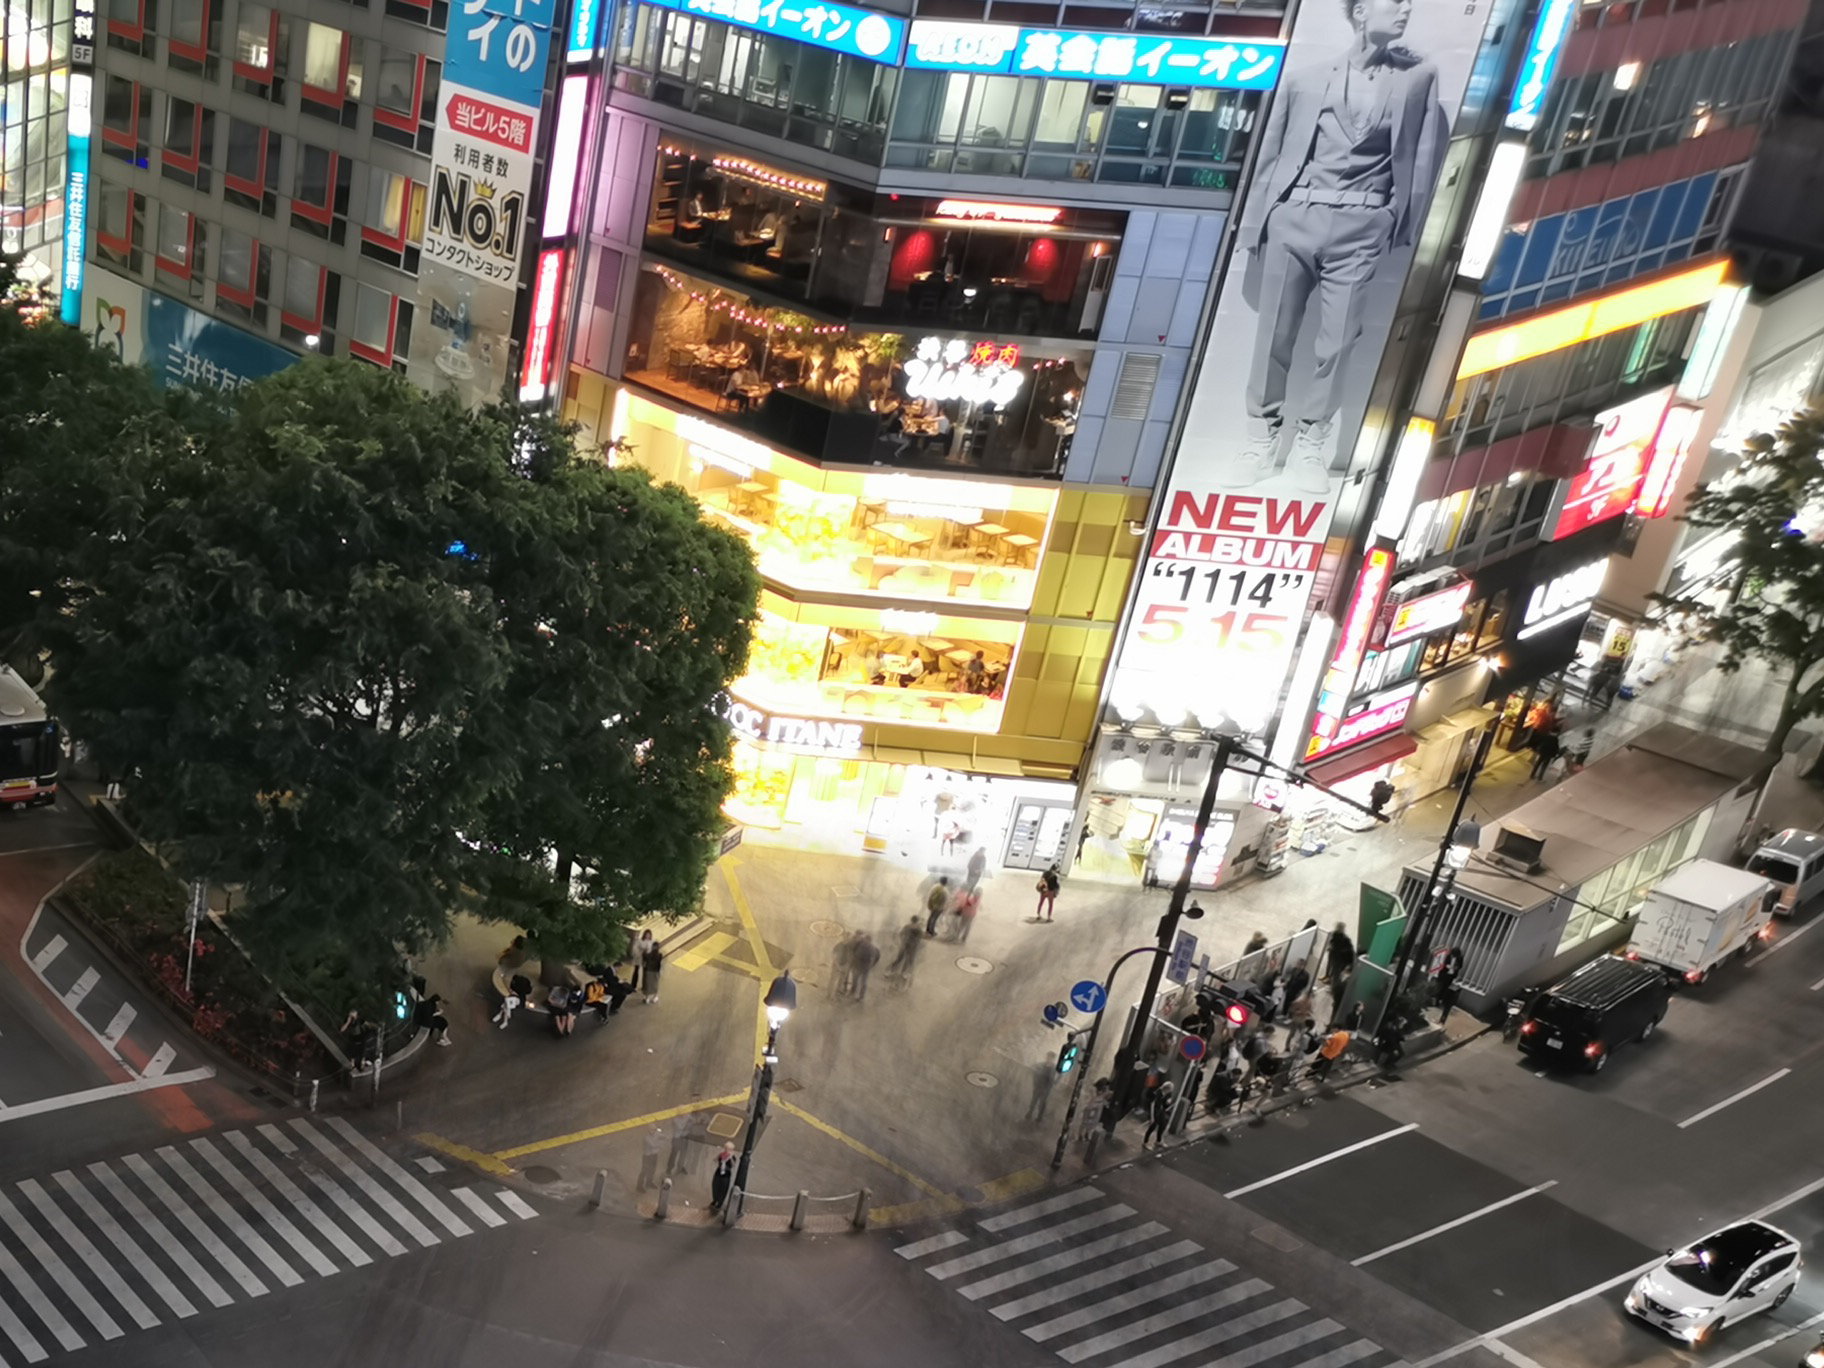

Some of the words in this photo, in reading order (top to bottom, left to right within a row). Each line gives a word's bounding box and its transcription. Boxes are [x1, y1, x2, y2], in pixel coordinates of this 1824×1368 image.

[74, 47, 91, 60] 5F
[924, 32, 1002, 63] AEON
[1019, 32, 1276, 81] 英会話イーオン
[455, 101, 526, 146] 当ビル5階
[453, 143, 509, 179] 利用者数
[428, 164, 525, 262] No.1
[424, 236, 516, 282] コンタクトショップ
[1167, 490, 1327, 537] NEW
[1155, 532, 1314, 569] ALBUM
